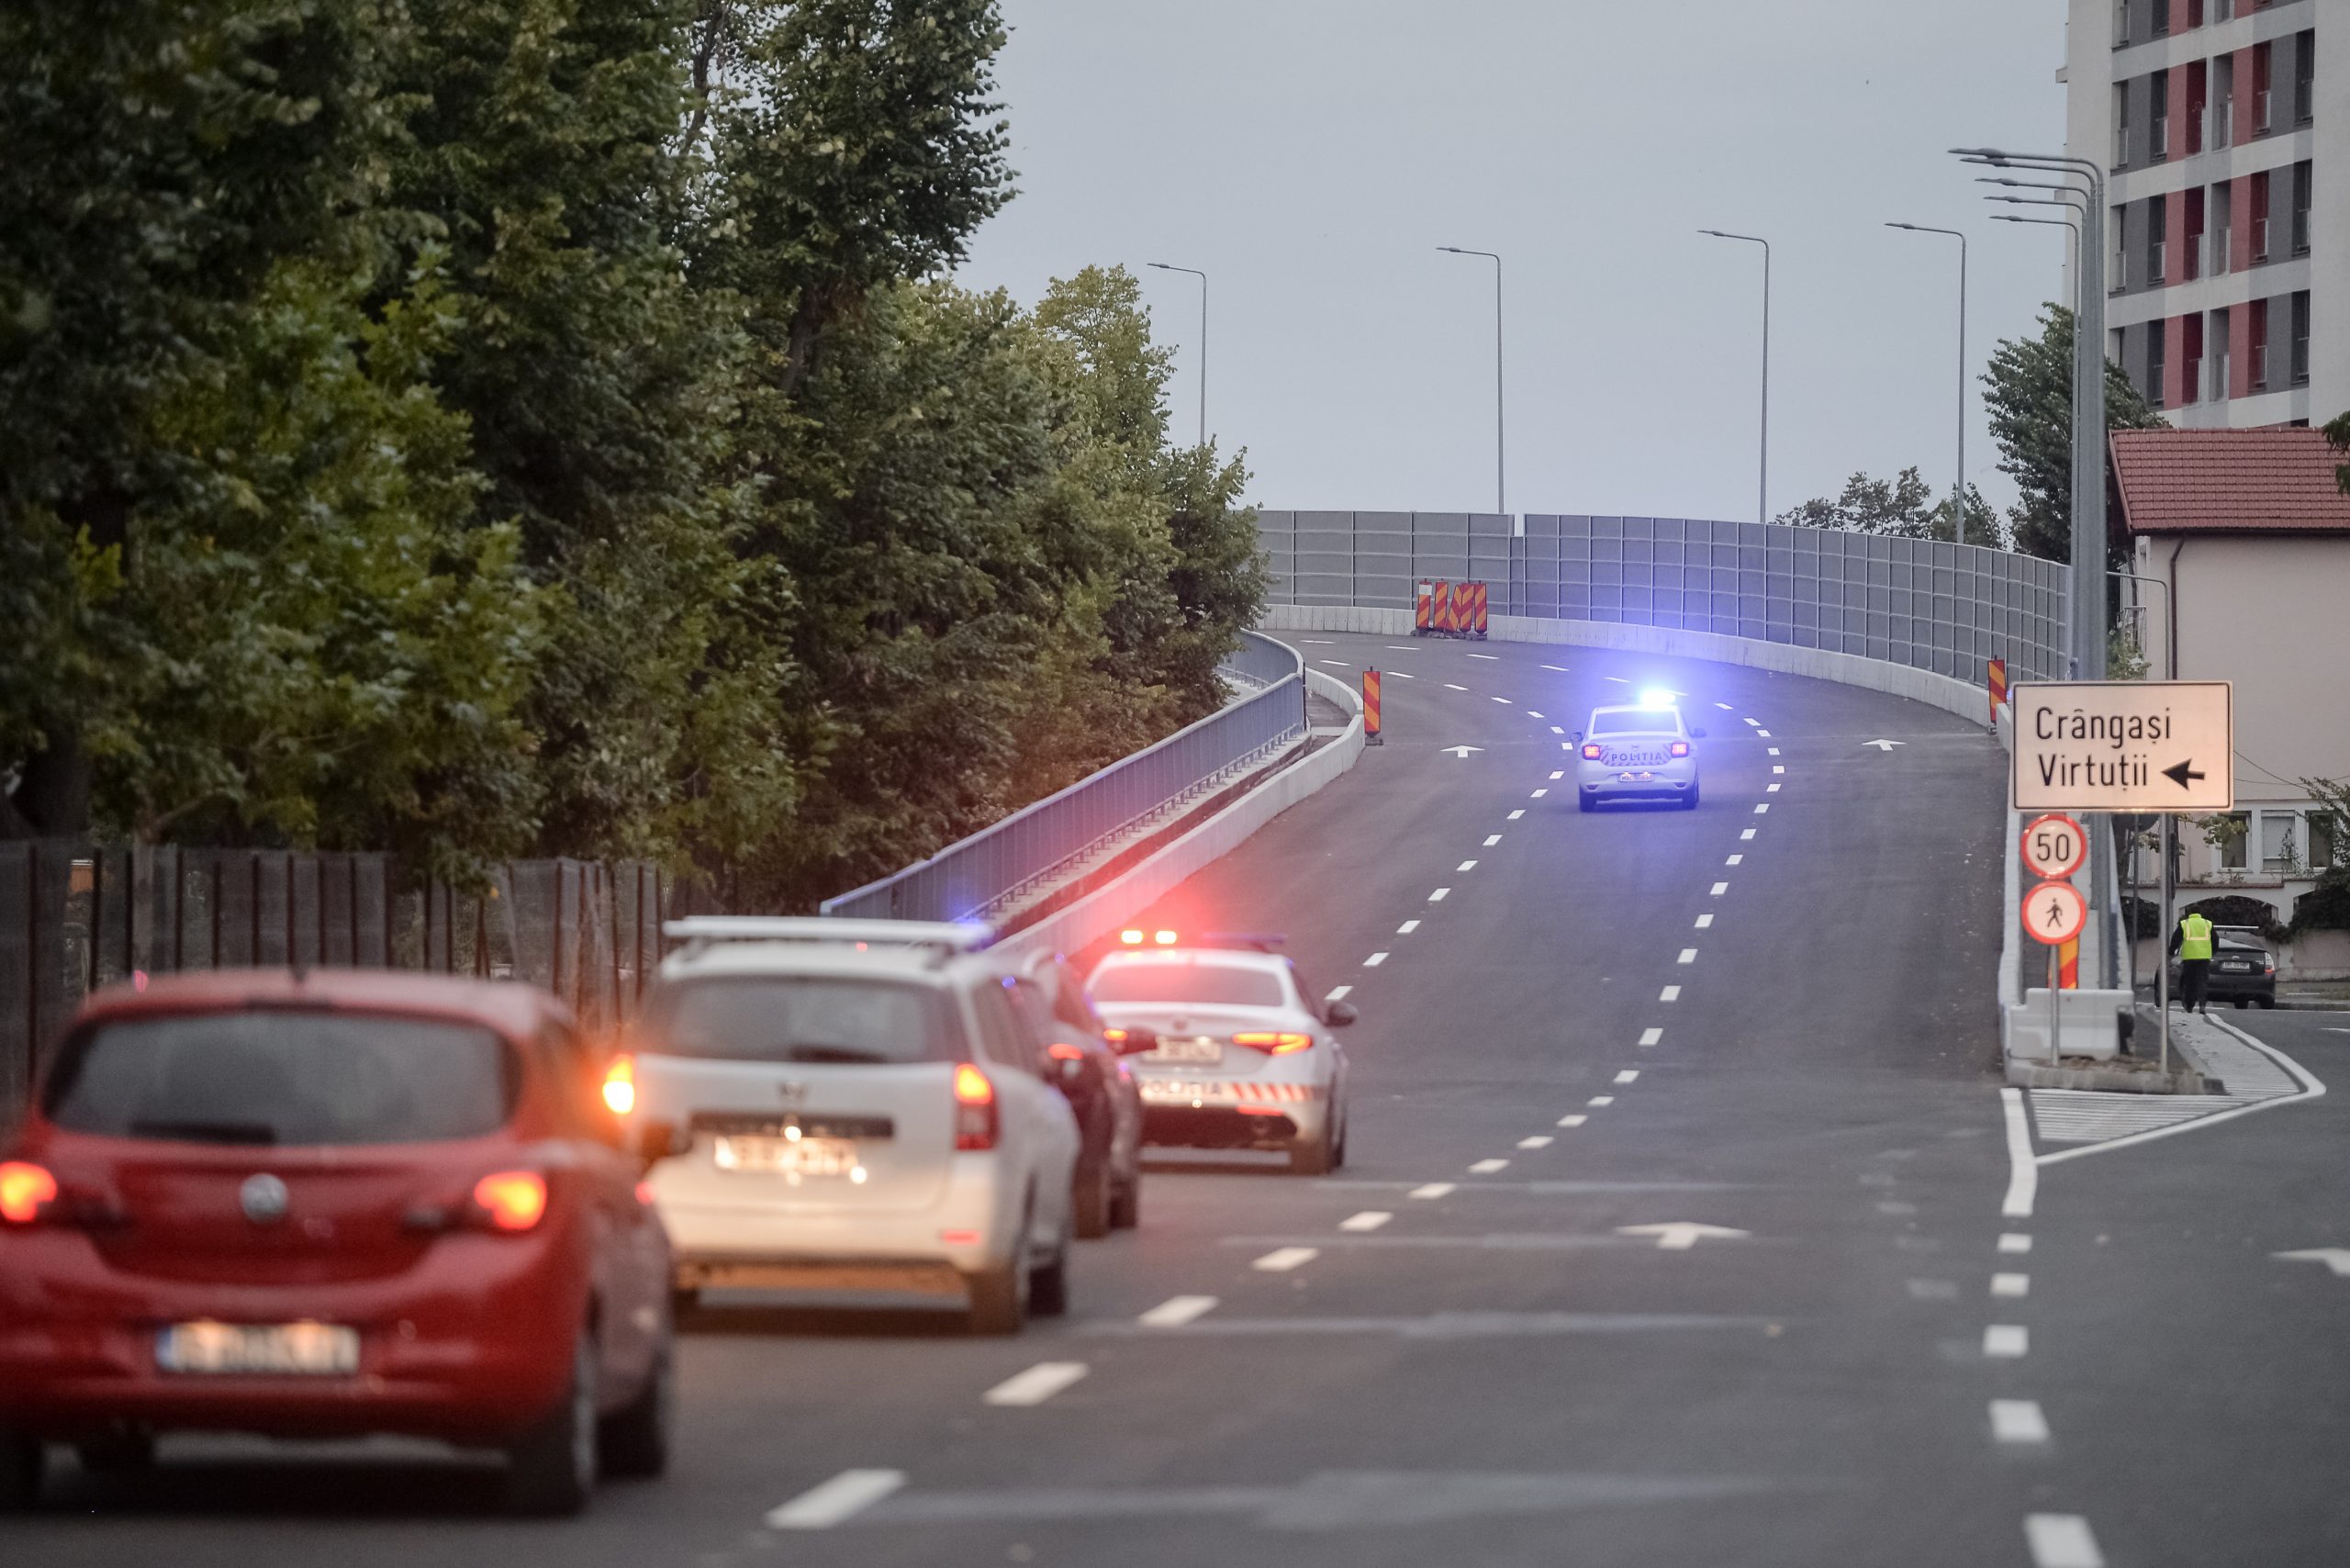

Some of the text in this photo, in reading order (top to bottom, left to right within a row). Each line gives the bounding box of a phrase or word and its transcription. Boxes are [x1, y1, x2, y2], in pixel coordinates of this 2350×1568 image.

[2036, 706, 2172, 749] Crângași
[2038, 754, 2148, 791] Virtuții
[2036, 833, 2071, 862] 50
